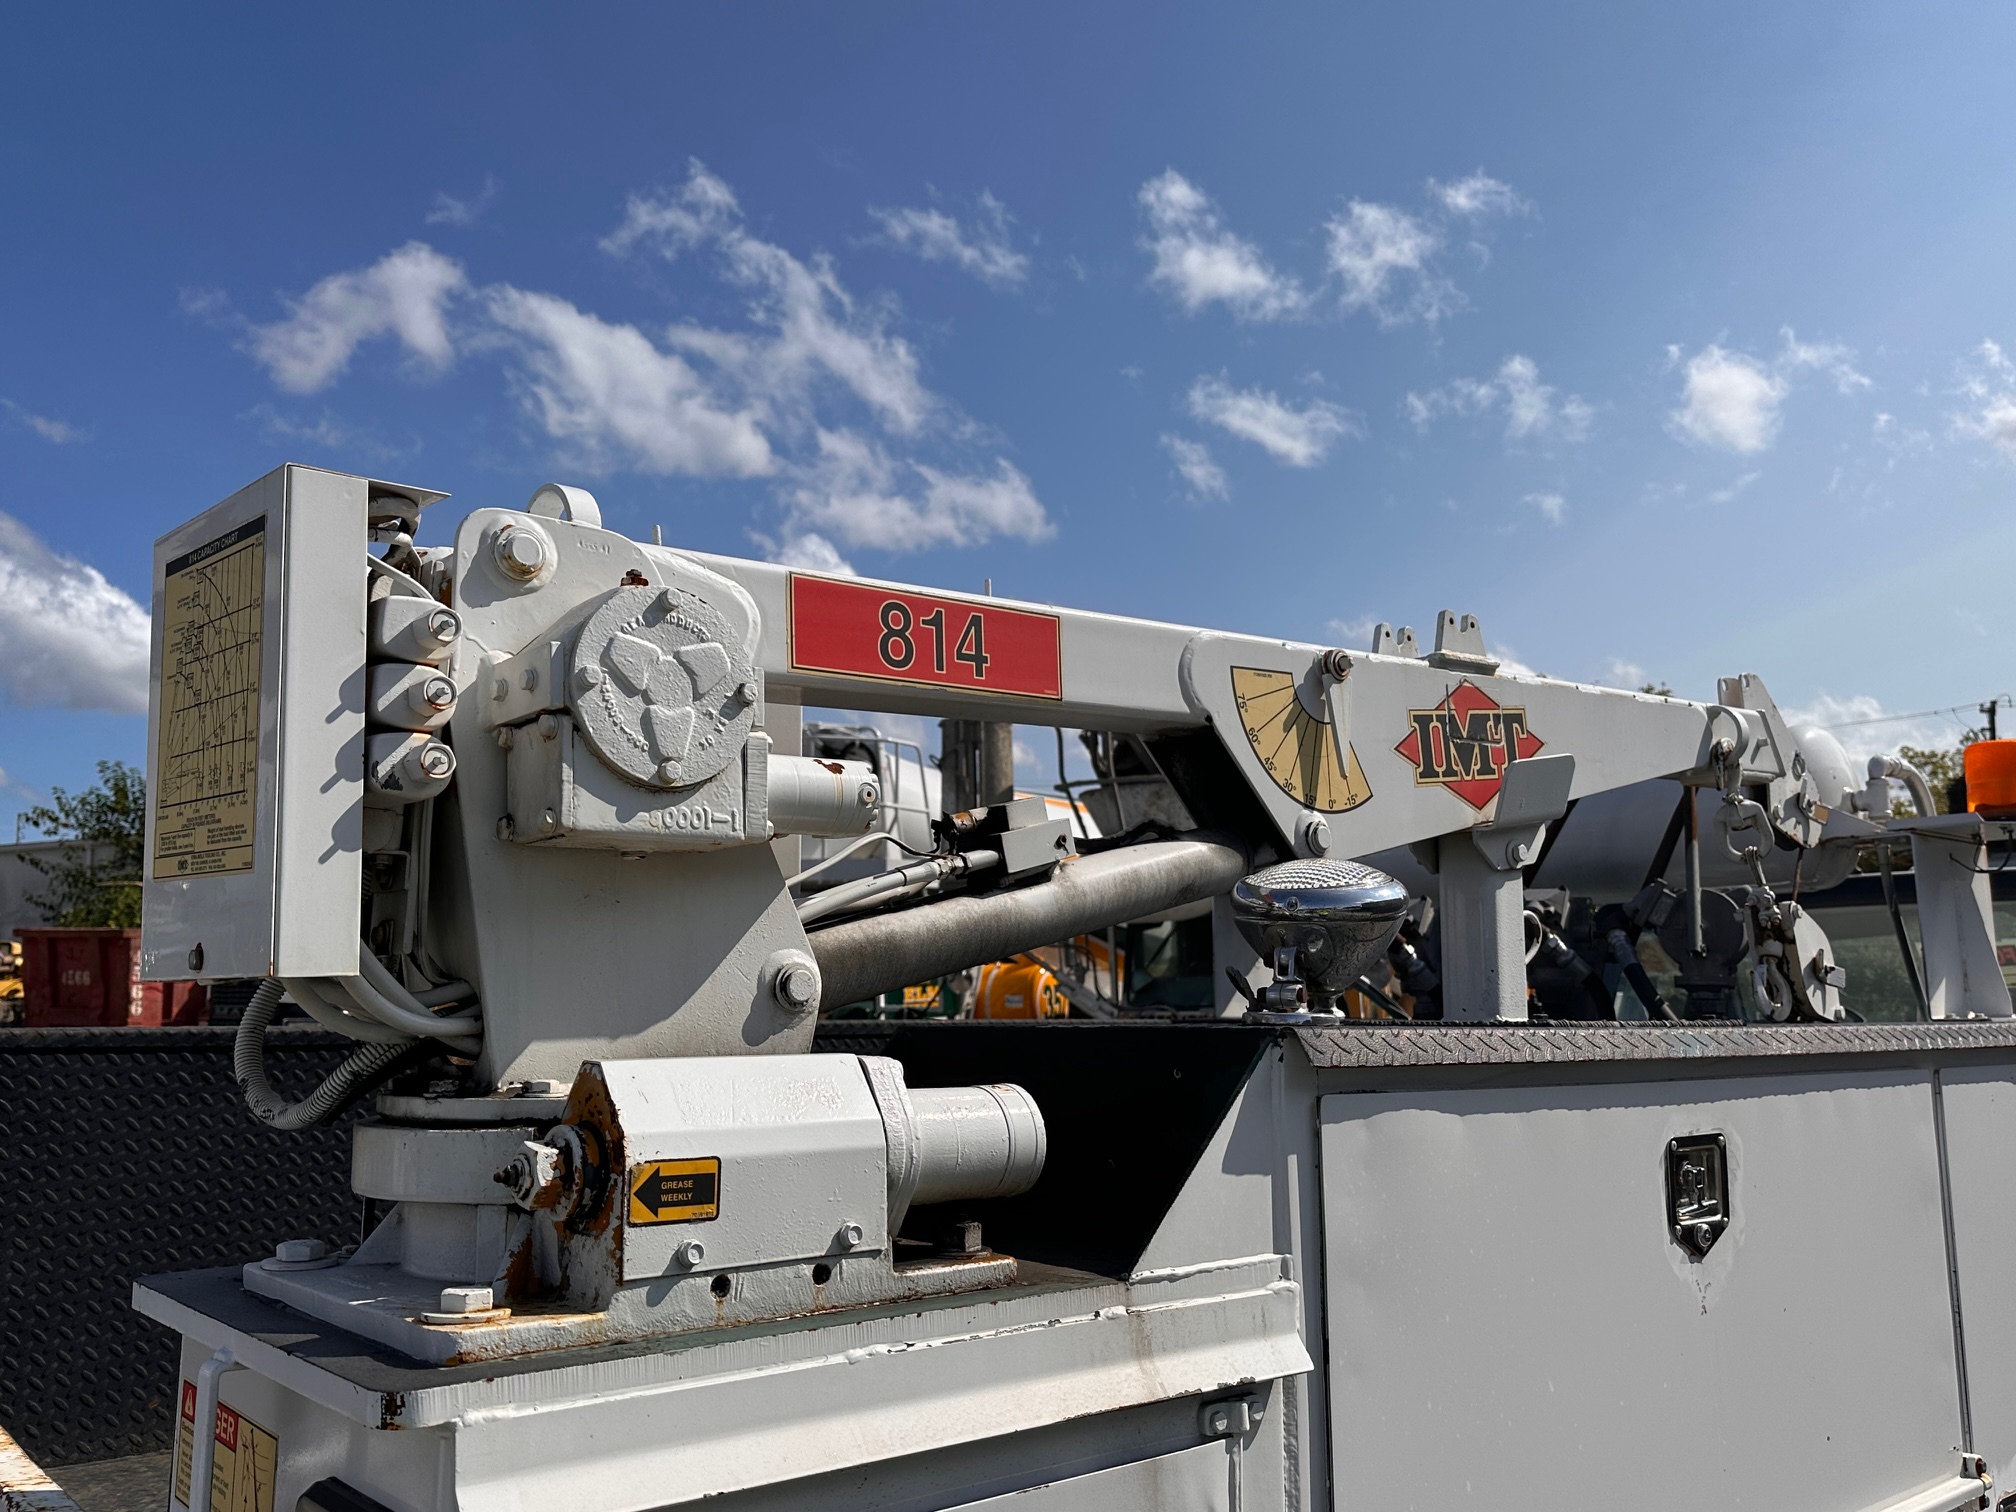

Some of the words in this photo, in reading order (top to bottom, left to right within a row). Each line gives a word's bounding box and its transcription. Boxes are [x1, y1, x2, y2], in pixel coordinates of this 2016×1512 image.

[198, 541, 221, 560] CAPACITY
[221, 531, 239, 549] CHART
[878, 599, 991, 680] 814
[1409, 708, 1527, 783] IMT
[660, 1192, 693, 1202] WEEKLY
[661, 1180, 694, 1190] GREASE
[215, 1407, 236, 1445] GER
